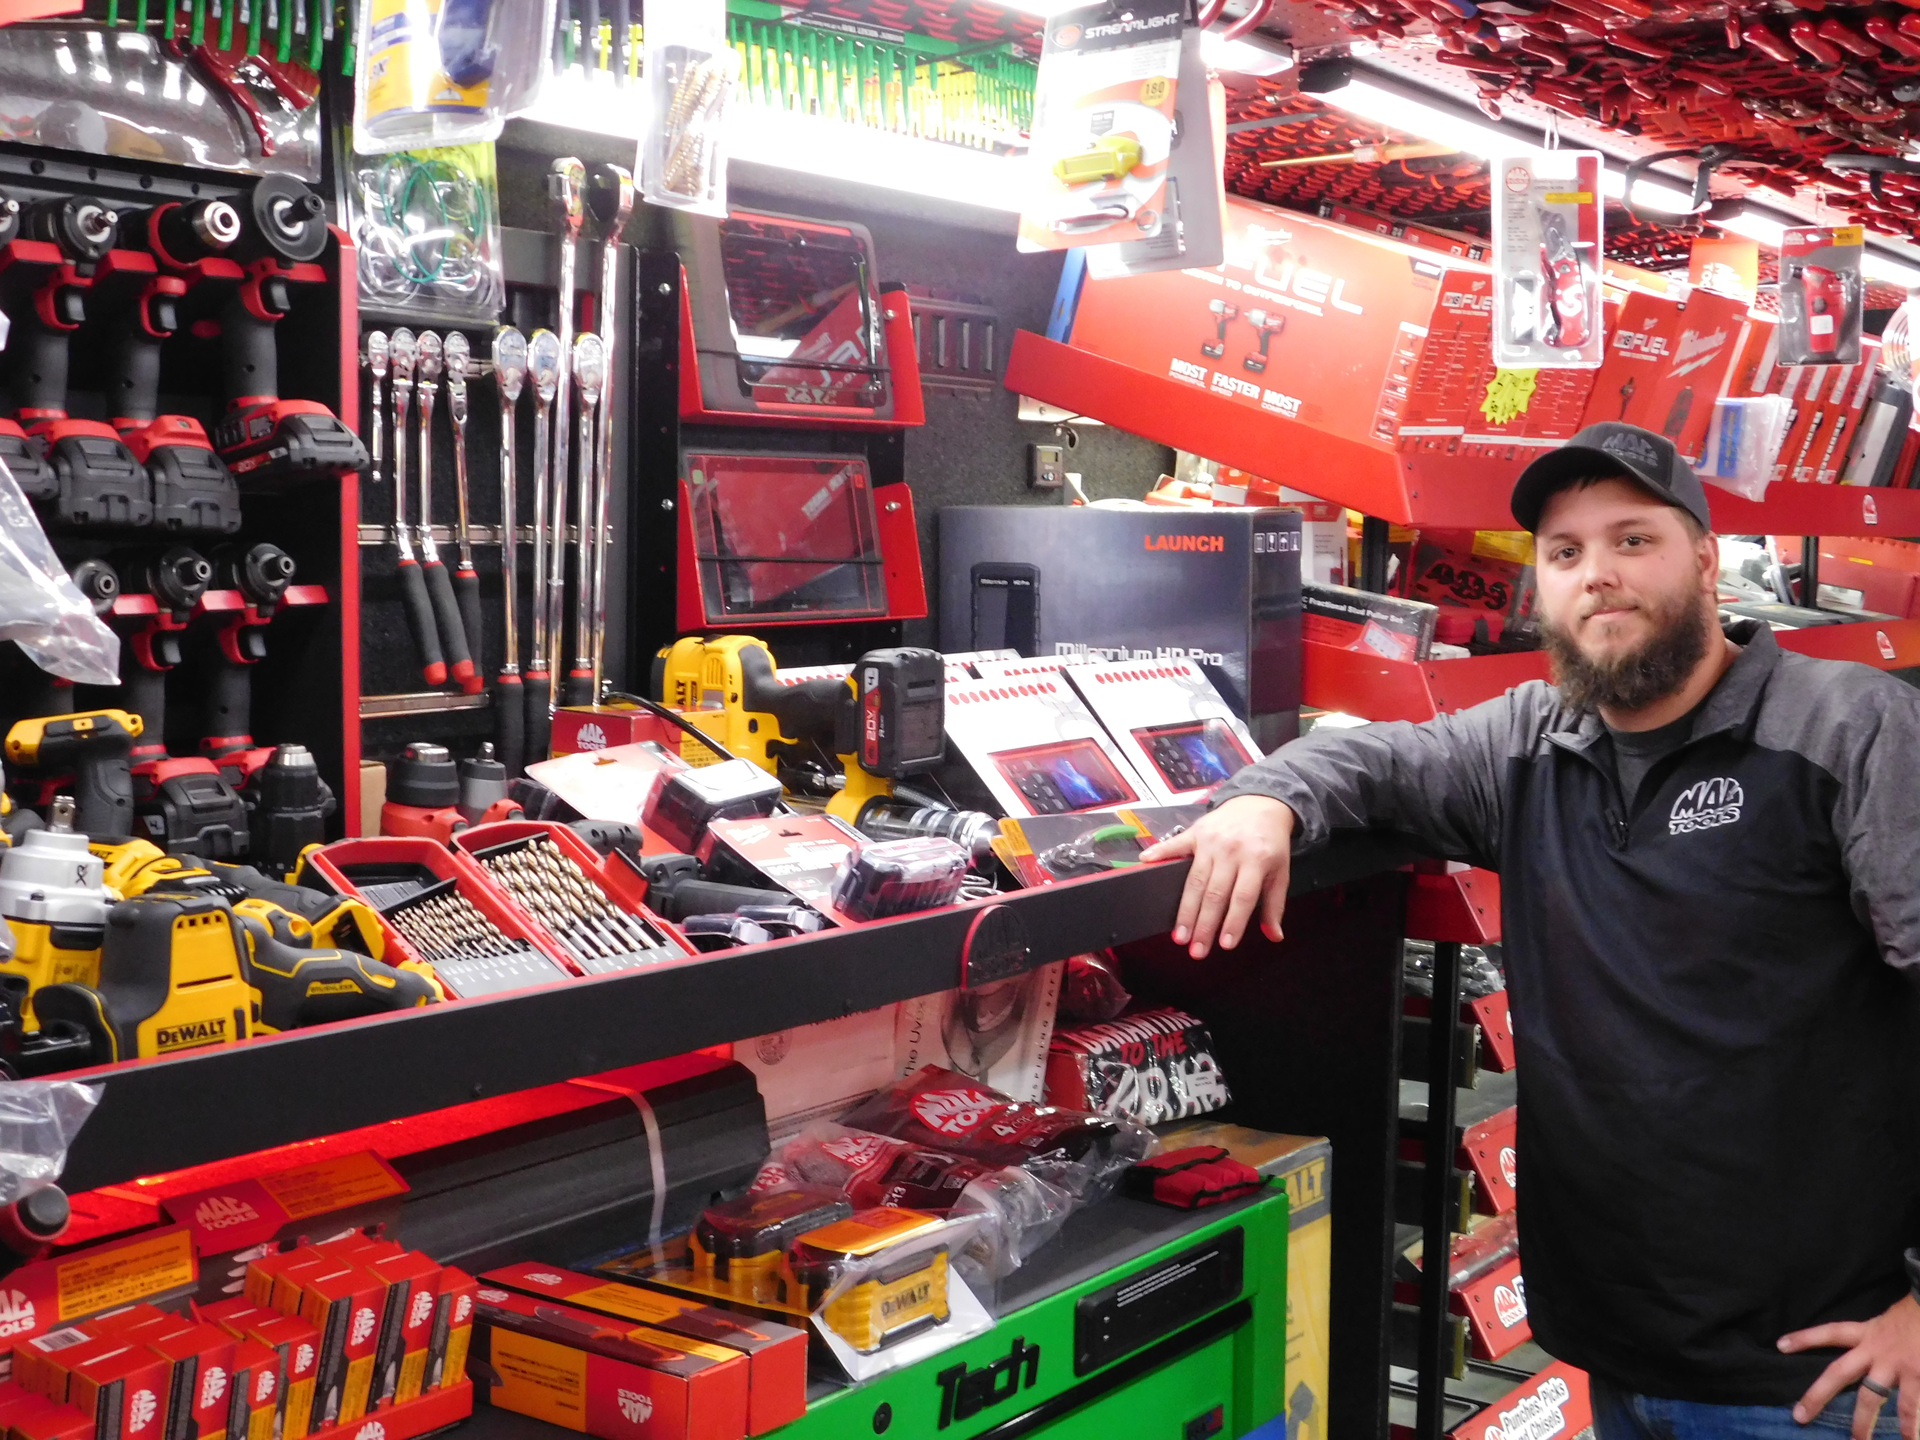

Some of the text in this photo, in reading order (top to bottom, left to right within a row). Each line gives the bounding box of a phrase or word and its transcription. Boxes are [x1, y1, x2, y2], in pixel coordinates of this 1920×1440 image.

[1085, 13, 1179, 39] STREAMLIGHT
[1145, 81, 1165, 95] 180
[1460, 293, 1494, 311] FUE
[1633, 333, 1670, 357] FUEL
[1170, 358, 1208, 381] MOST
[1211, 372, 1261, 400] FASTER
[1262, 388, 1303, 413] MOST
[1602, 432, 1659, 461] MAC
[1144, 534, 1224, 552] LAUNCH
[1308, 597, 1347, 612] Fractional
[1347, 605, 1366, 616] Stud
[1366, 609, 1390, 621] Puller
[1389, 614, 1404, 624] Set
[1188, 648, 1224, 666] Pro
[675, 679, 686, 706] ALT
[577, 722, 607, 745] MAC
[866, 710, 877, 742] 20V
[1670, 777, 1745, 820] MAC
[1668, 807, 1741, 836] TOOLS
[157, 1019, 226, 1046] DeWALT
[1062, 1008, 1203, 1055] UARANTINE
[1031, 1019, 1049, 1104] NSPIRING
[1120, 1030, 1188, 1066] TO THE
[991, 1123, 1017, 1137] 4
[1286, 1161, 1326, 1208] ALT
[195, 1196, 254, 1224] MAC
[201, 1210, 260, 1231] TOOLS
[0, 1289, 35, 1322] AC
[0, 1315, 36, 1338] OLS
[936, 1335, 1041, 1432] Tech
[1503, 1400, 1543, 1434] Punches,
[1541, 1381, 1566, 1407] Picks
[1529, 1409, 1561, 1440] Chisels
